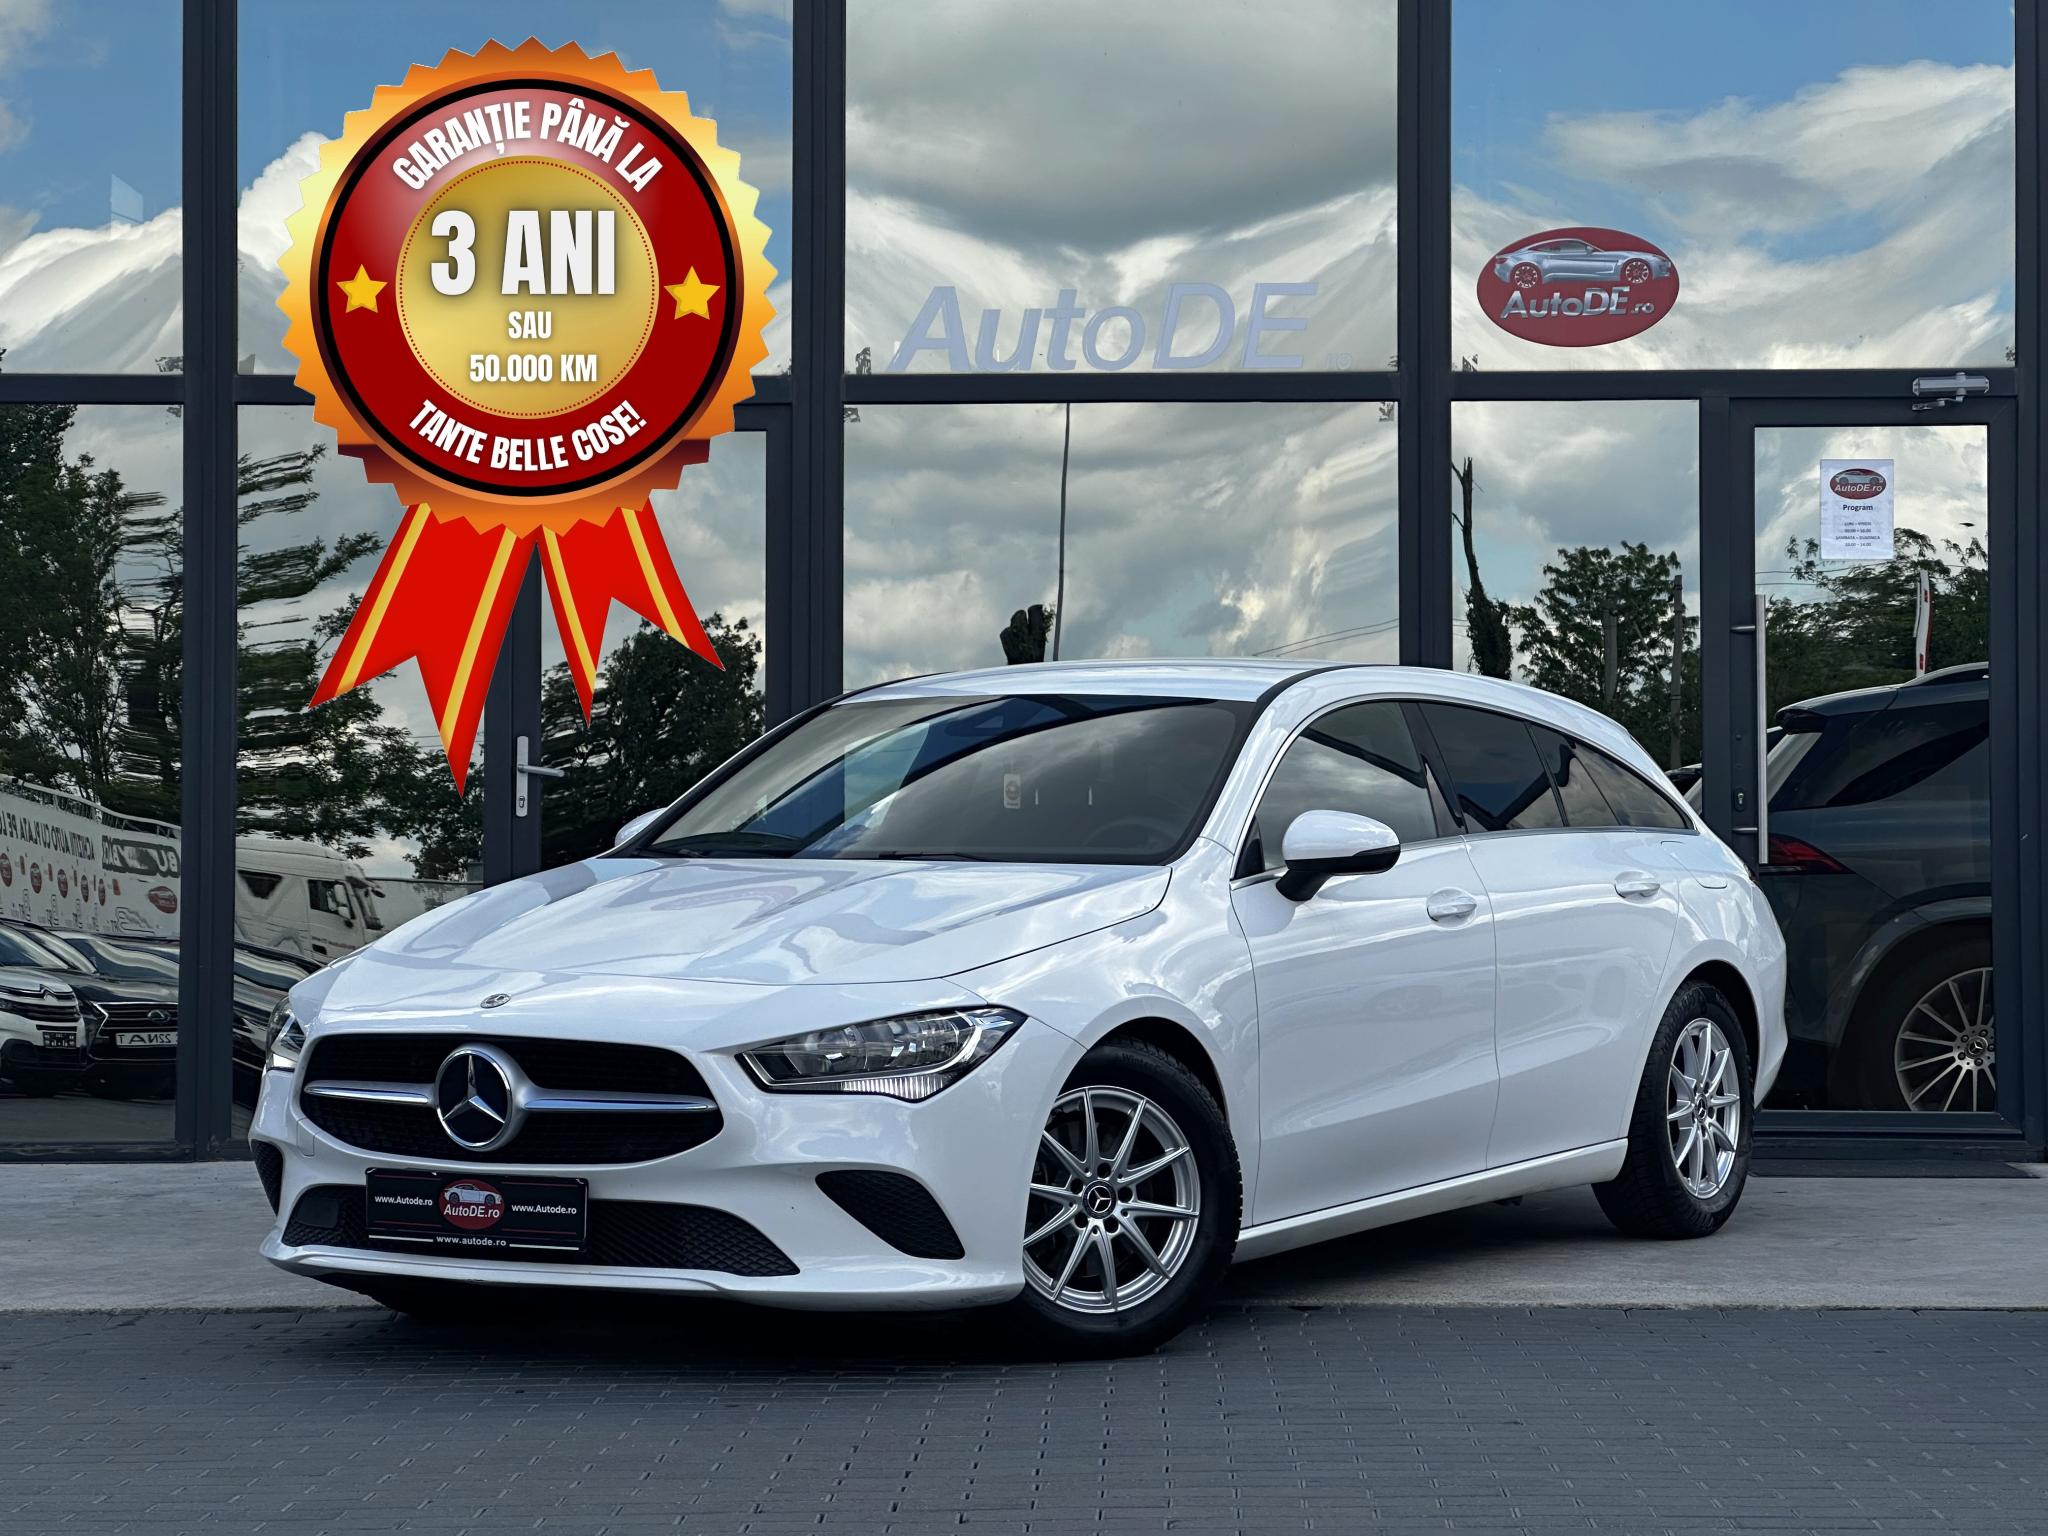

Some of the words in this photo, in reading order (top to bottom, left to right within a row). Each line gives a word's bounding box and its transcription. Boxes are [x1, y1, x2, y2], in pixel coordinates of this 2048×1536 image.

[886, 281, 1320, 374] AutoDE
[1842, 504, 1874, 512] Program
[374, 1194, 433, 1207] www.Autode.ro
[443, 1203, 500, 1219] AutoDE.ro
[511, 1203, 577, 1215] www.Autode.ro
[436, 1235, 507, 1247] www.autode.ro
